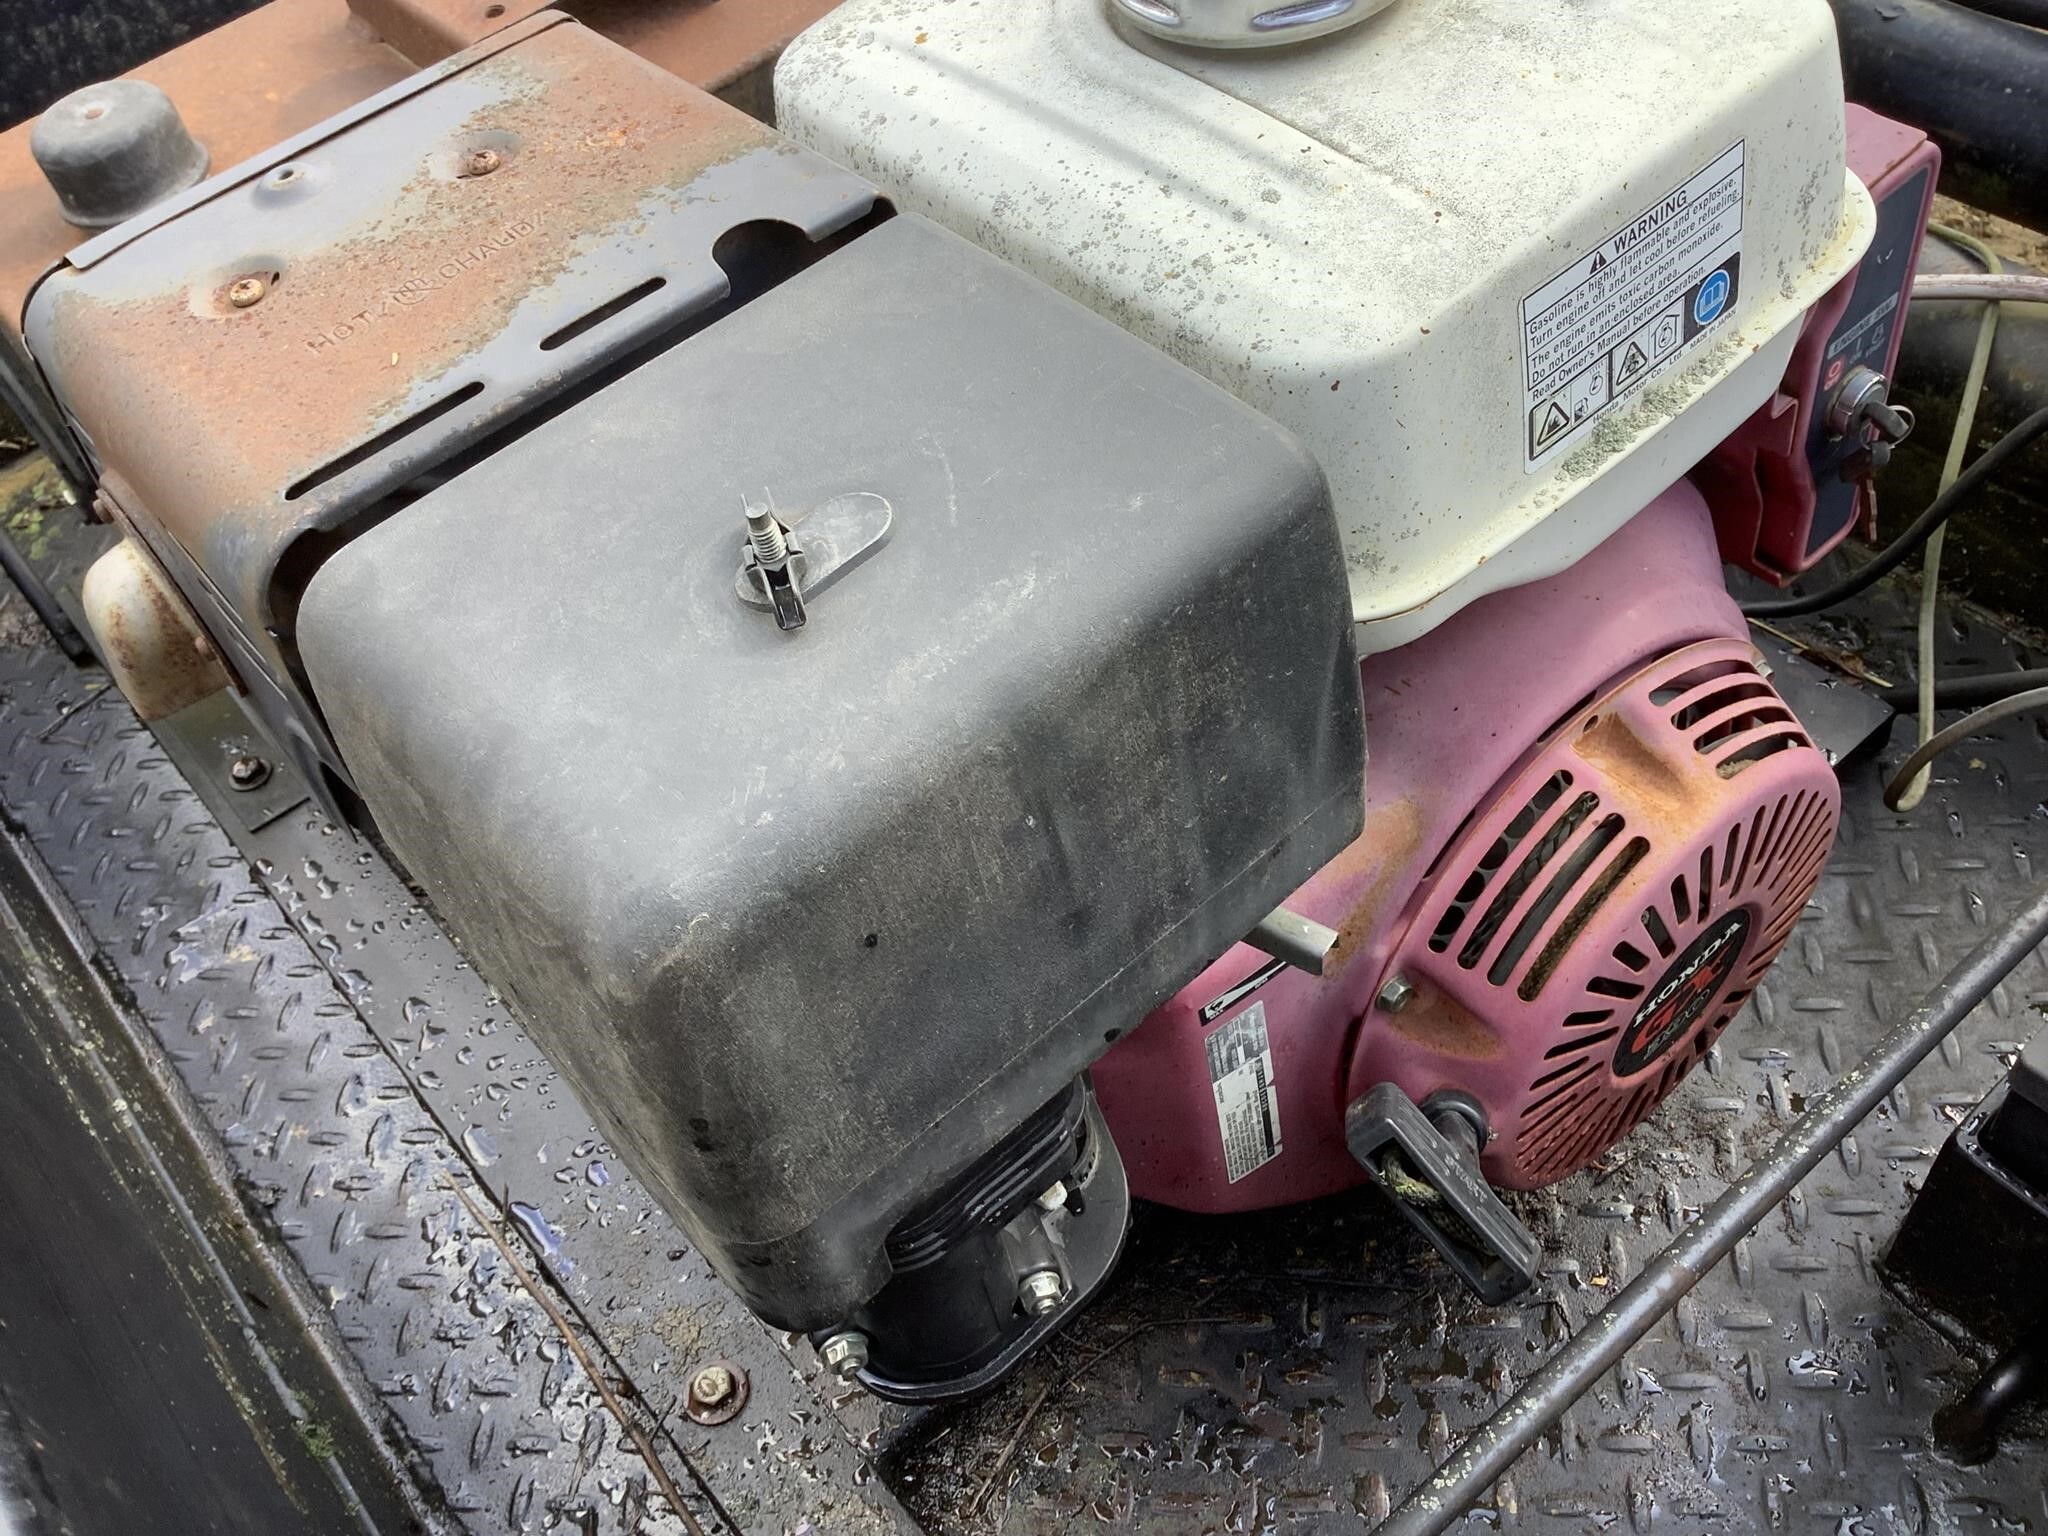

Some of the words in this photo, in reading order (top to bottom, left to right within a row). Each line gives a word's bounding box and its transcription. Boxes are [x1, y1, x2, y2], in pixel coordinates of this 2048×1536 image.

[1530, 292, 1573, 334] Gasoline
[1575, 283, 1584, 302] is
[1587, 260, 1617, 293] highly
[1619, 220, 1670, 270] flammable
[1672, 206, 1689, 230] and
[1692, 178, 1736, 215] explosive.
[1530, 328, 1552, 348] Turn
[1556, 301, 1589, 330] engine
[1593, 284, 1605, 304] off
[1609, 270, 1626, 292] and
[1630, 260, 1641, 277] let
[1644, 242, 1663, 265] cool
[1666, 222, 1695, 249] before
[1698, 189, 1739, 225] refueling.
[1614, 190, 1686, 254] WARNING
[1531, 351, 1549, 369] The
[1553, 324, 1586, 353] engine
[1589, 301, 1616, 326] emits
[1619, 283, 1640, 304] toxic
[1644, 257, 1674, 286] carbon
[1678, 222, 1723, 260] monoxide.
[1532, 368, 1545, 383] Do
[1549, 352, 1564, 371] not
[1566, 340, 1583, 358] run
[1587, 330, 1595, 343] in
[1613, 283, 1654, 322] enclosed
[1658, 269, 1680, 289] area.
[1532, 375, 1555, 401] Read
[1559, 349, 1594, 381] Owner's
[1597, 319, 1630, 353] Manual
[1633, 299, 1661, 326] before
[1663, 266, 1705, 302] operation.
[1592, 399, 1619, 423] Honda
[1622, 378, 1647, 400] Motor
[1633, 922, 1742, 1028] HONDA
